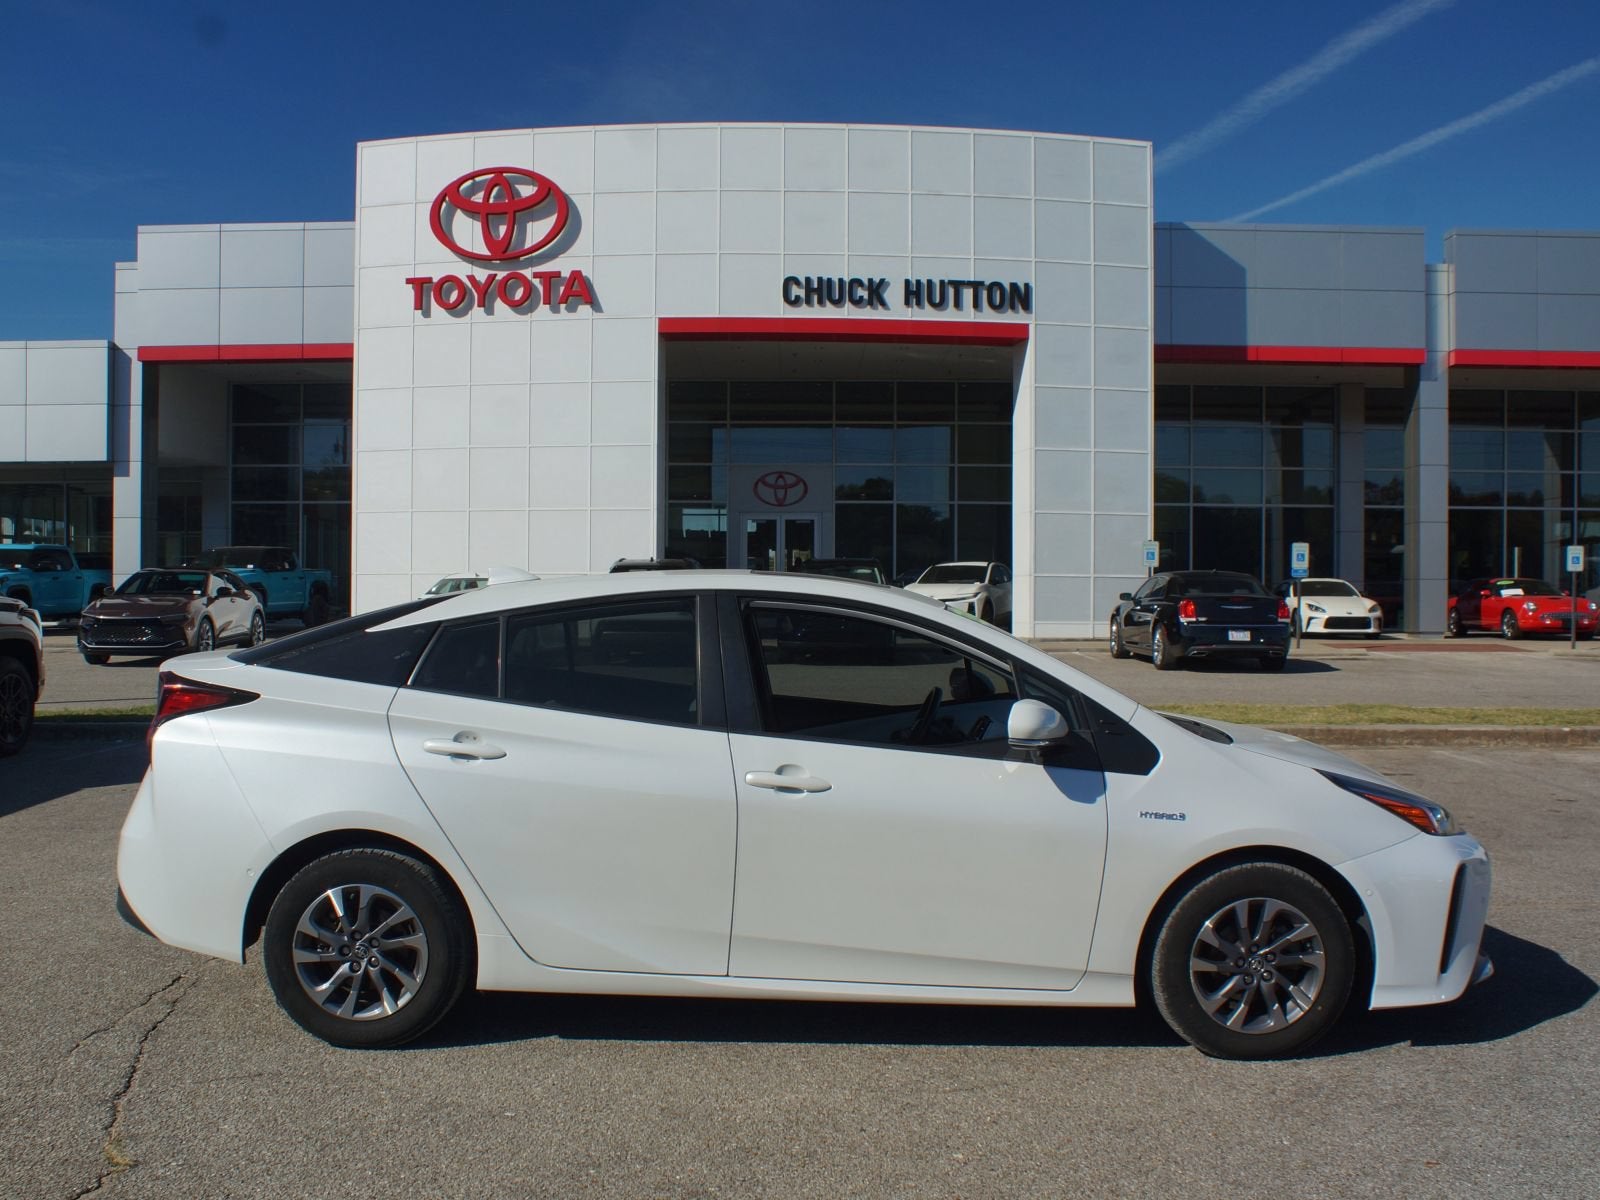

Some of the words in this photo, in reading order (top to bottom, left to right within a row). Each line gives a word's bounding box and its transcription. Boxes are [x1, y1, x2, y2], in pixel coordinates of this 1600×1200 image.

[405, 270, 594, 311] TOYOTA
[782, 275, 887, 307] CHUCK
[903, 278, 1031, 312] HUTTON
